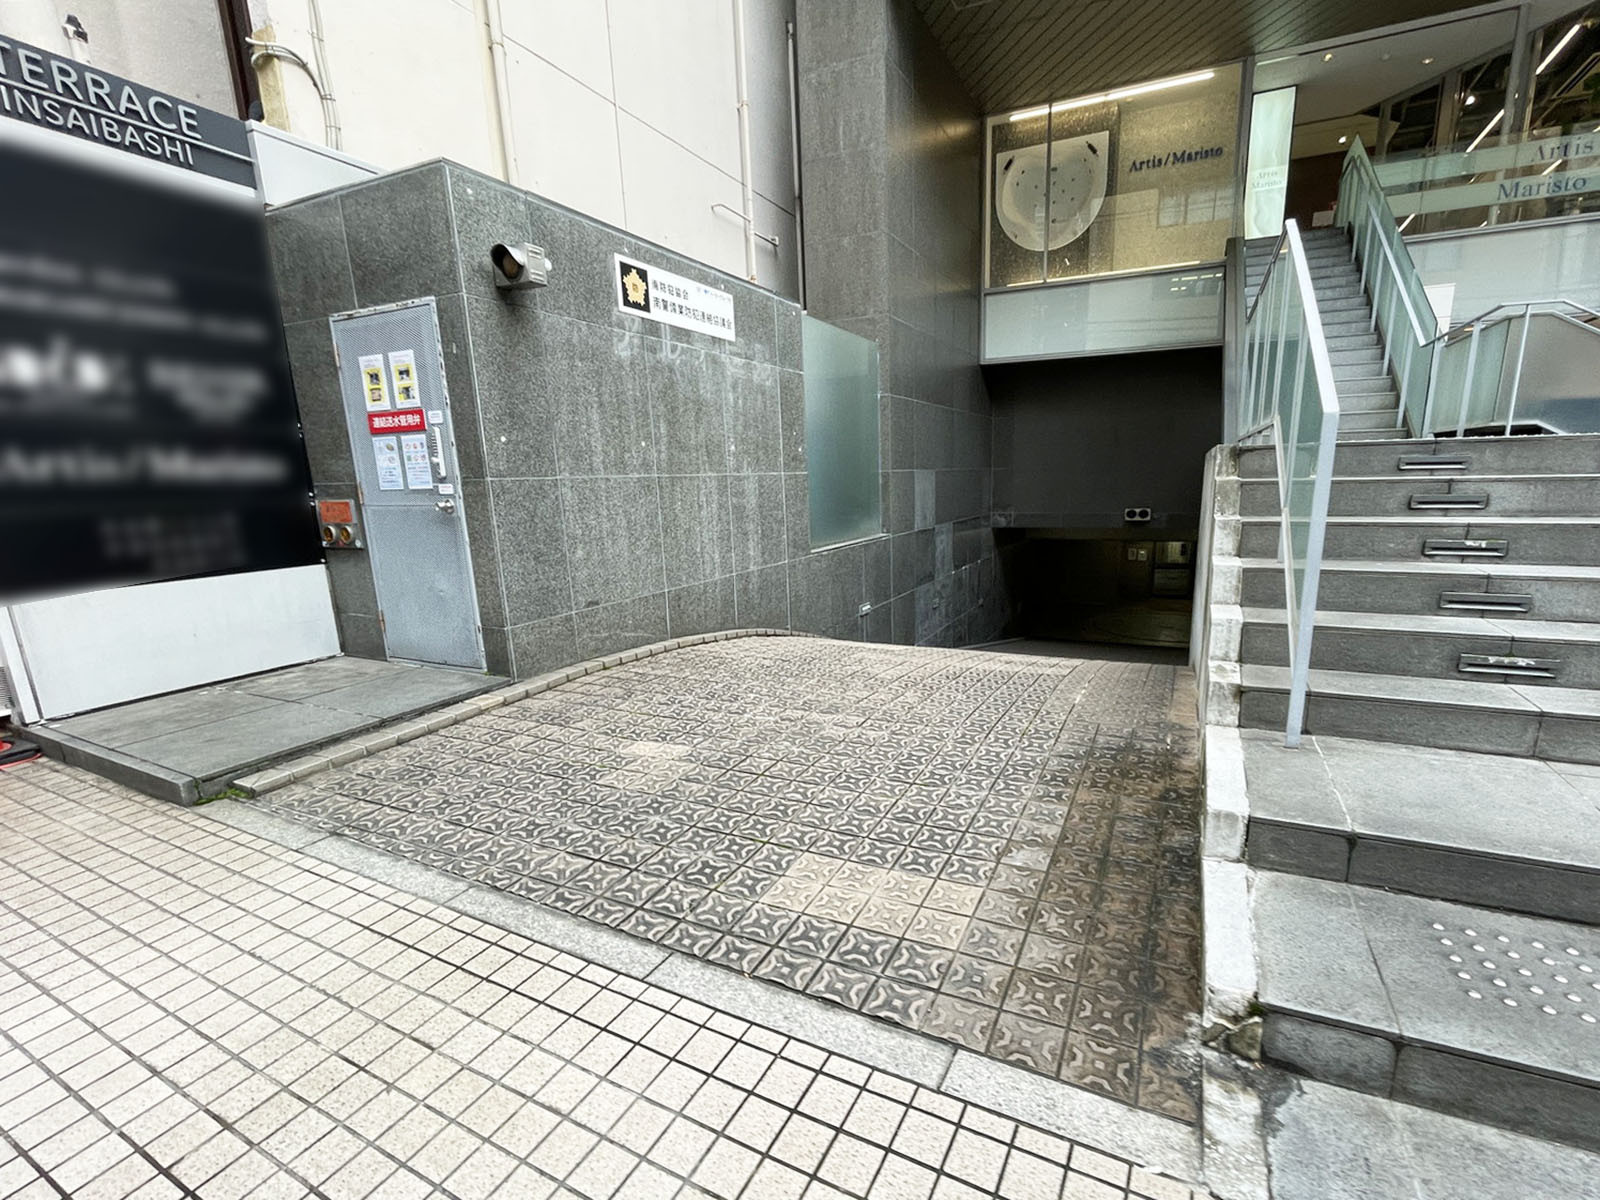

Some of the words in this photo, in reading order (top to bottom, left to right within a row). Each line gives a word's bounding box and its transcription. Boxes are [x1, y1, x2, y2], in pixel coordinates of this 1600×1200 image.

[0, 40, 202, 140] TERRACE
[1129, 146, 1224, 173] Artis/Maristo
[1531, 137, 1594, 162] Artis
[1497, 176, 1587, 200] Maristo
